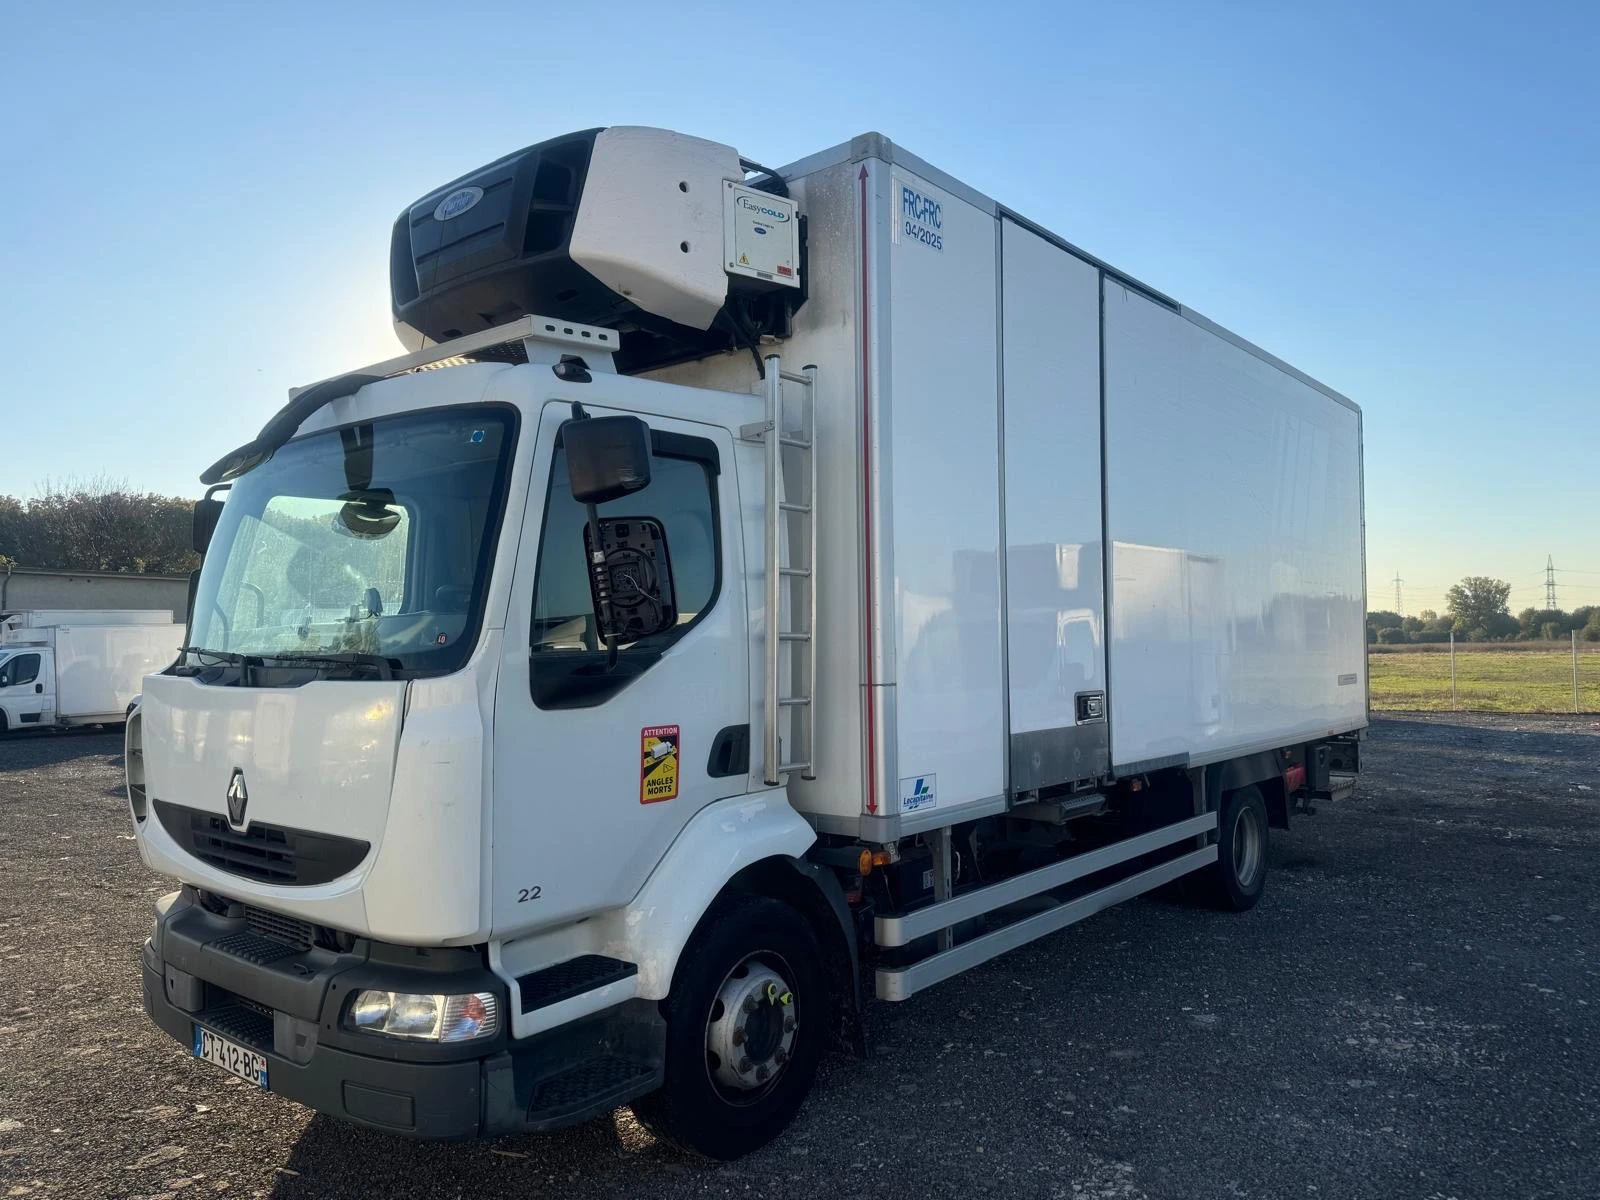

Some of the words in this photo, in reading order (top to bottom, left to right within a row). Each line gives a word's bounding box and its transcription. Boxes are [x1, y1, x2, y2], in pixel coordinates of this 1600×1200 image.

[743, 199, 785, 219] EasyCOLD
[903, 187, 942, 229] FRC-FRC
[905, 221, 942, 250] 04/2025
[644, 727, 678, 737] ATTENTION
[646, 776, 674, 788] ANGLES
[647, 785, 672, 795] MORTS
[518, 886, 541, 903] 22
[202, 1031, 260, 1082] CT-412-BG
